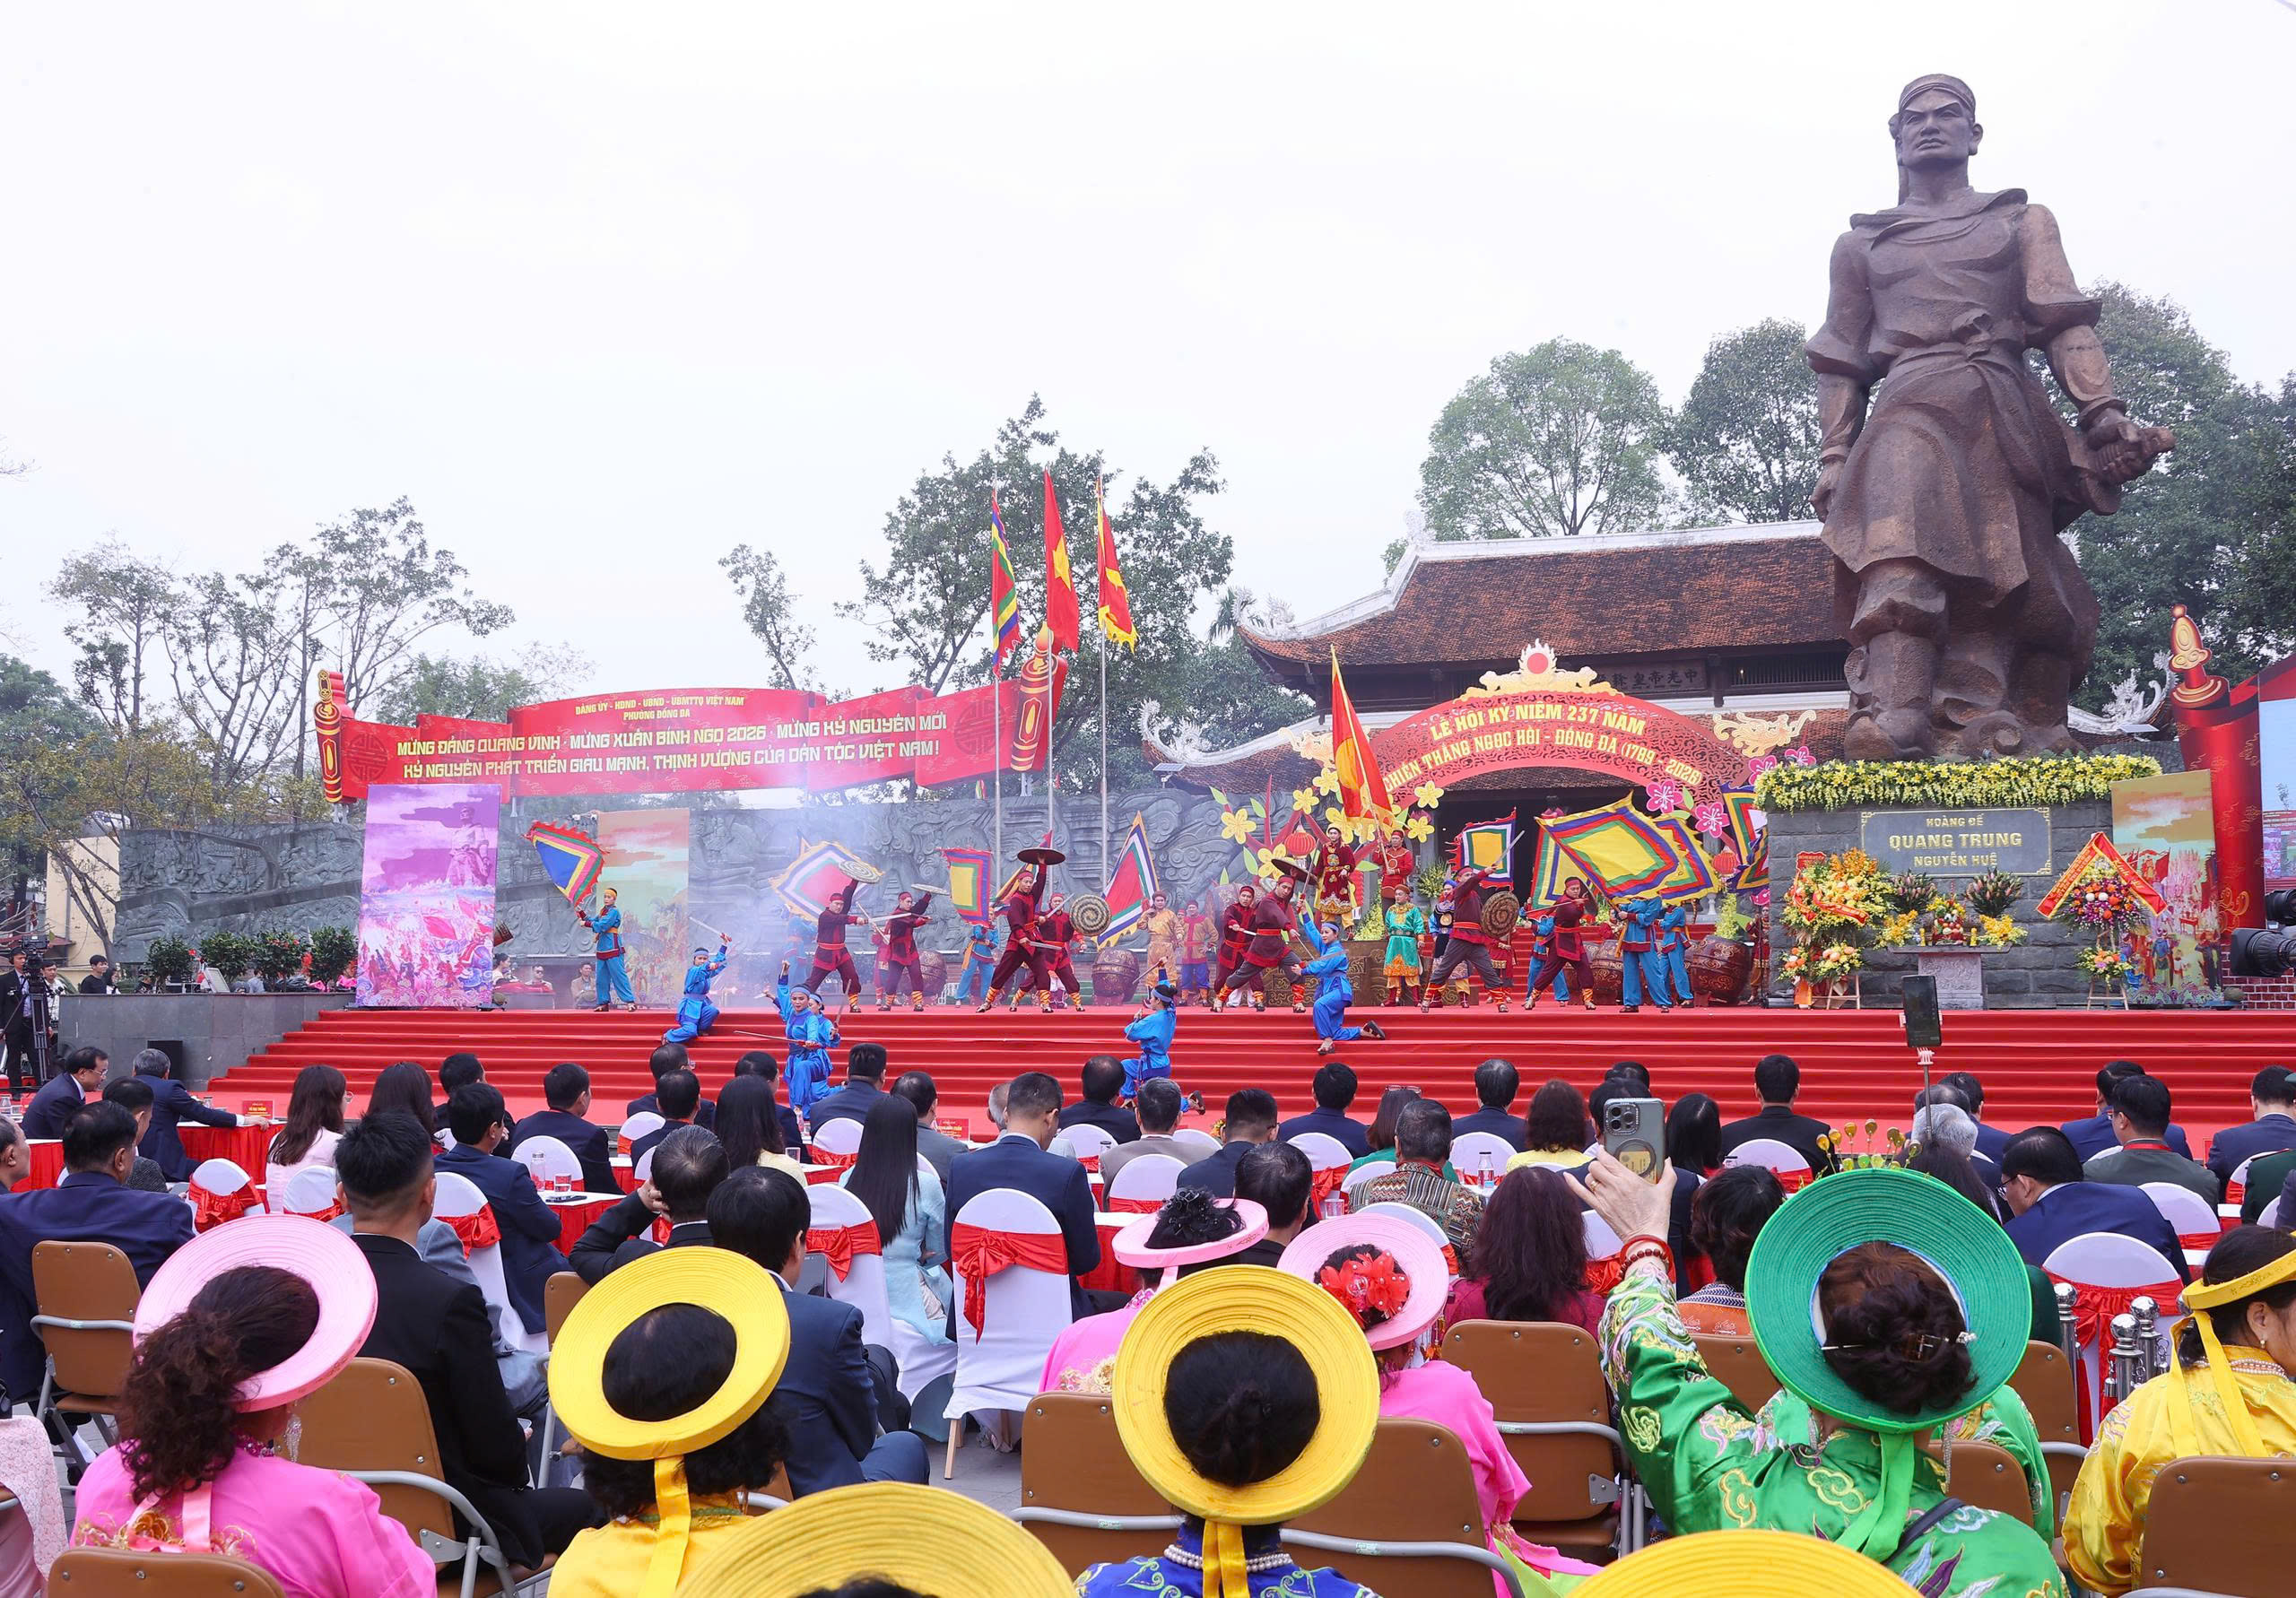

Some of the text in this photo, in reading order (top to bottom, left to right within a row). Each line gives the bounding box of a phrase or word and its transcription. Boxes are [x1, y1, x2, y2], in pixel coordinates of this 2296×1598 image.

[642, 697, 665, 708] UBND
[671, 696, 703, 706] UBMTTQ
[705, 695, 724, 707] VIỆT
[724, 696, 744, 706] NAM
[397, 736, 435, 756] MỪNG
[438, 735, 475, 754] ĐẢNG
[477, 736, 526, 753] QUANG
[528, 734, 561, 751] VINH
[570, 729, 610, 750] MỪNG
[613, 727, 653, 747] XUÂN
[656, 725, 691, 746] BÍNH
[694, 727, 724, 746] NGỌ
[726, 725, 767, 743] 2026
[777, 717, 821, 739] MỪNG
[823, 715, 846, 736] KỶ
[849, 713, 916, 734] NGUYÊN
[919, 710, 947, 731] MỚI
[1431, 716, 1452, 741] LỄ
[1454, 709, 1485, 733] HỘI
[1516, 700, 1562, 721] NIỆM
[1567, 705, 1599, 727] 237
[1602, 709, 1646, 735] NĂM
[404, 760, 422, 778] KỶ
[425, 759, 483, 777] NGUYÊN
[485, 757, 521, 775] PHÁT
[525, 752, 567, 774] TRIỂN
[570, 752, 603, 773] GIÀU
[606, 756, 650, 775] MẠNH,
[653, 753, 698, 772] THỊNH
[700, 749, 751, 770] VƯỢNG
[754, 744, 785, 765] CỦA
[789, 743, 821, 763] DÂN
[824, 741, 855, 763] TỘC
[858, 739, 895, 761] VIỆT
[1382, 759, 1422, 792] CHIẾN
[1421, 741, 1472, 769] THẮNG
[1474, 731, 1512, 753] NGỌC
[1596, 734, 1618, 753] ĐA
[1621, 742, 1657, 765] (1789
[1665, 759, 1702, 786] 2026)
[1926, 812, 1985, 827] HOÀNG ĐẾ
[1889, 832, 2023, 851] QUANG TRUNG
[1913, 852, 1968, 867] NGUYỄN
